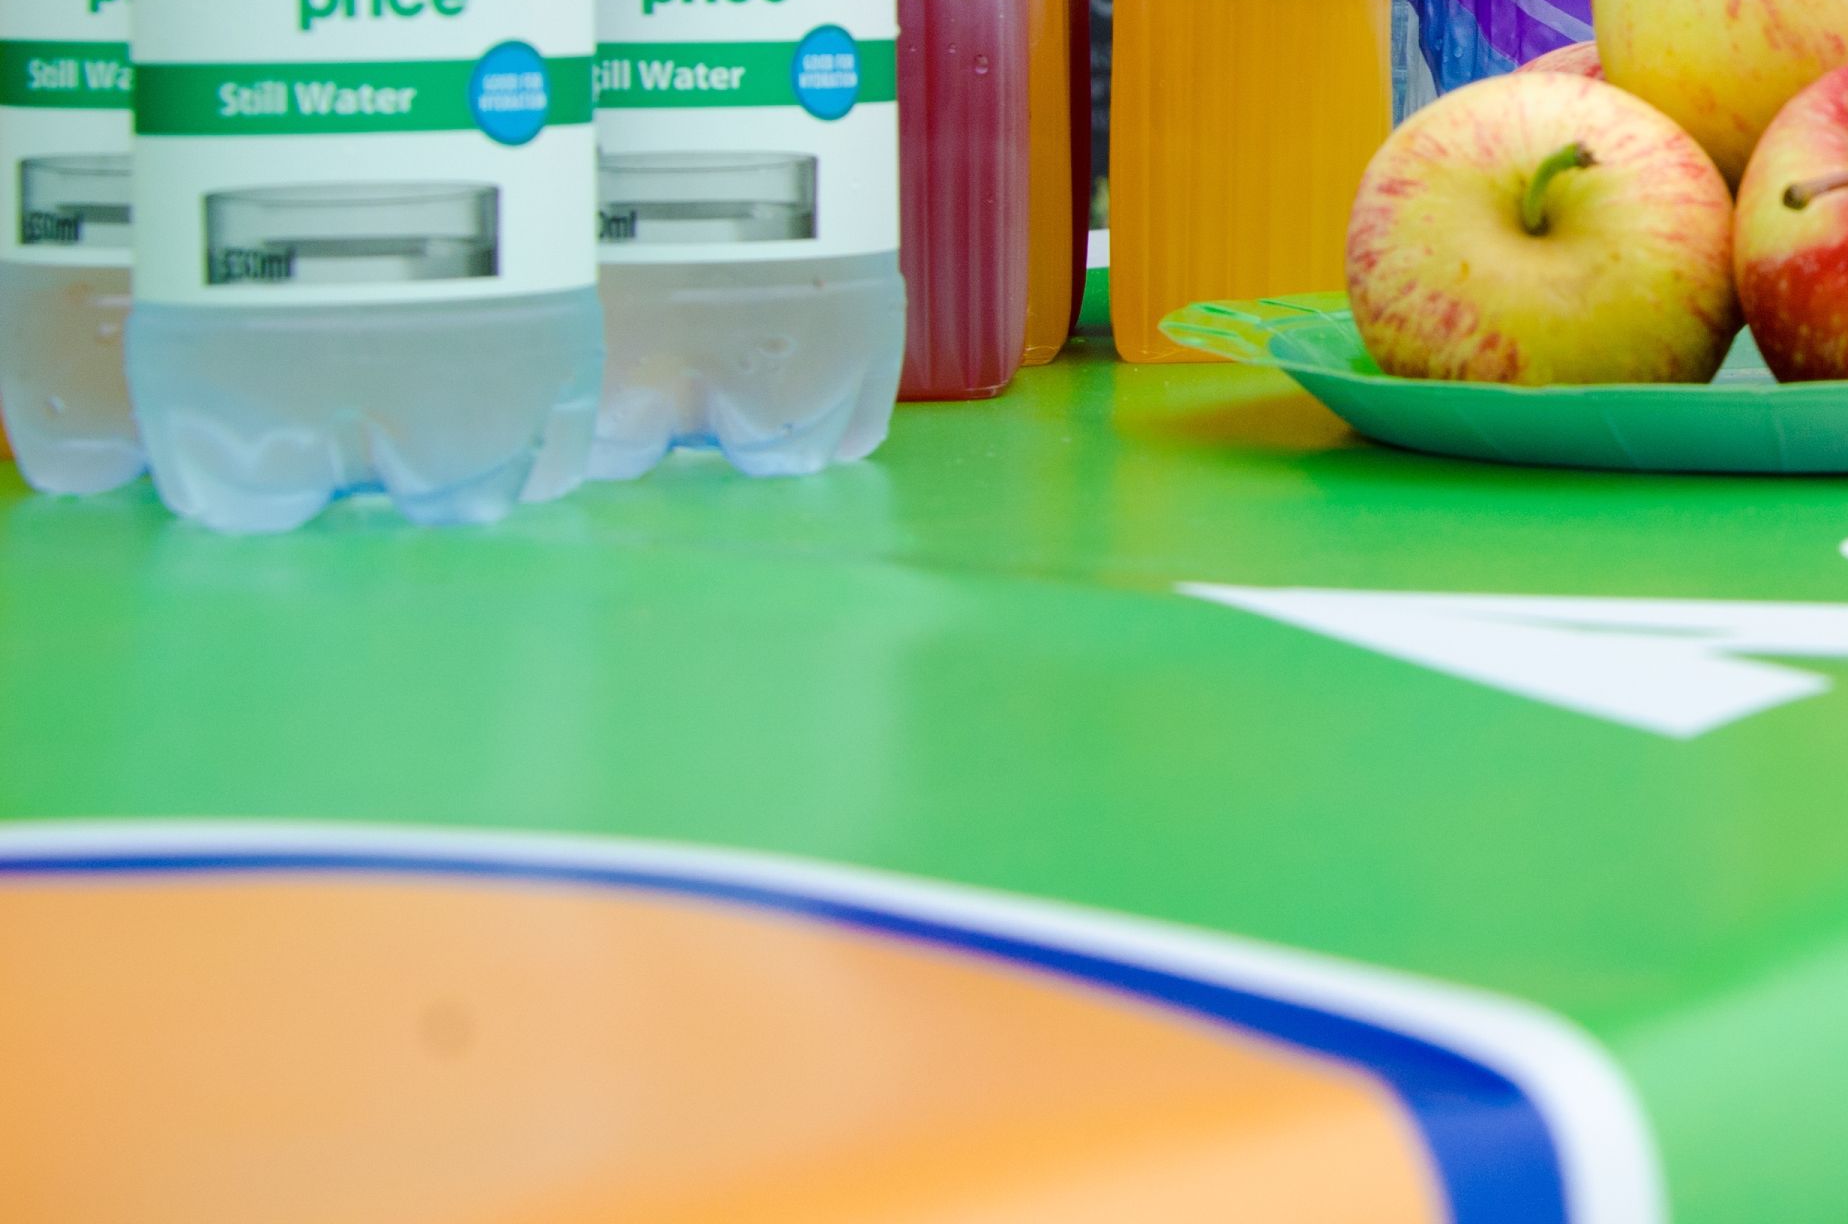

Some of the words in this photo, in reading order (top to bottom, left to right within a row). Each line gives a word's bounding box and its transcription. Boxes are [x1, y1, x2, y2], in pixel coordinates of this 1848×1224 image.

[28, 59, 77, 90] Still
[593, 60, 631, 91] ill
[638, 60, 745, 91] Water
[218, 81, 288, 117] Still
[295, 82, 417, 116] Water
